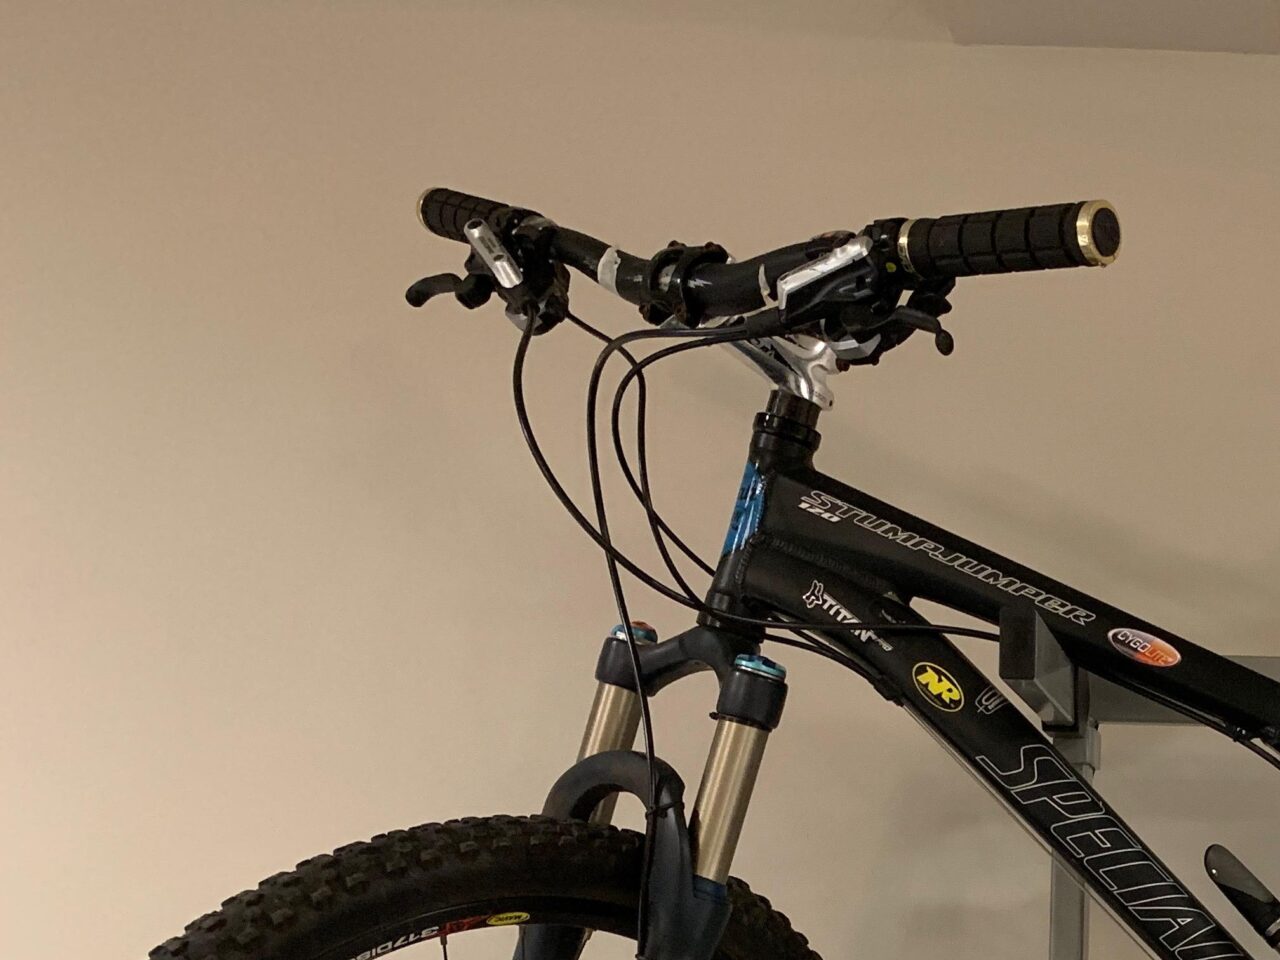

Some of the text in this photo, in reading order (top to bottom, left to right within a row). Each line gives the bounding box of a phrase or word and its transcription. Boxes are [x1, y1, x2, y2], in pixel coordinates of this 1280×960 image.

[799, 502, 841, 522] 120
[801, 490, 1096, 626] STUMPJUMPER
[917, 667, 962, 708] NR
